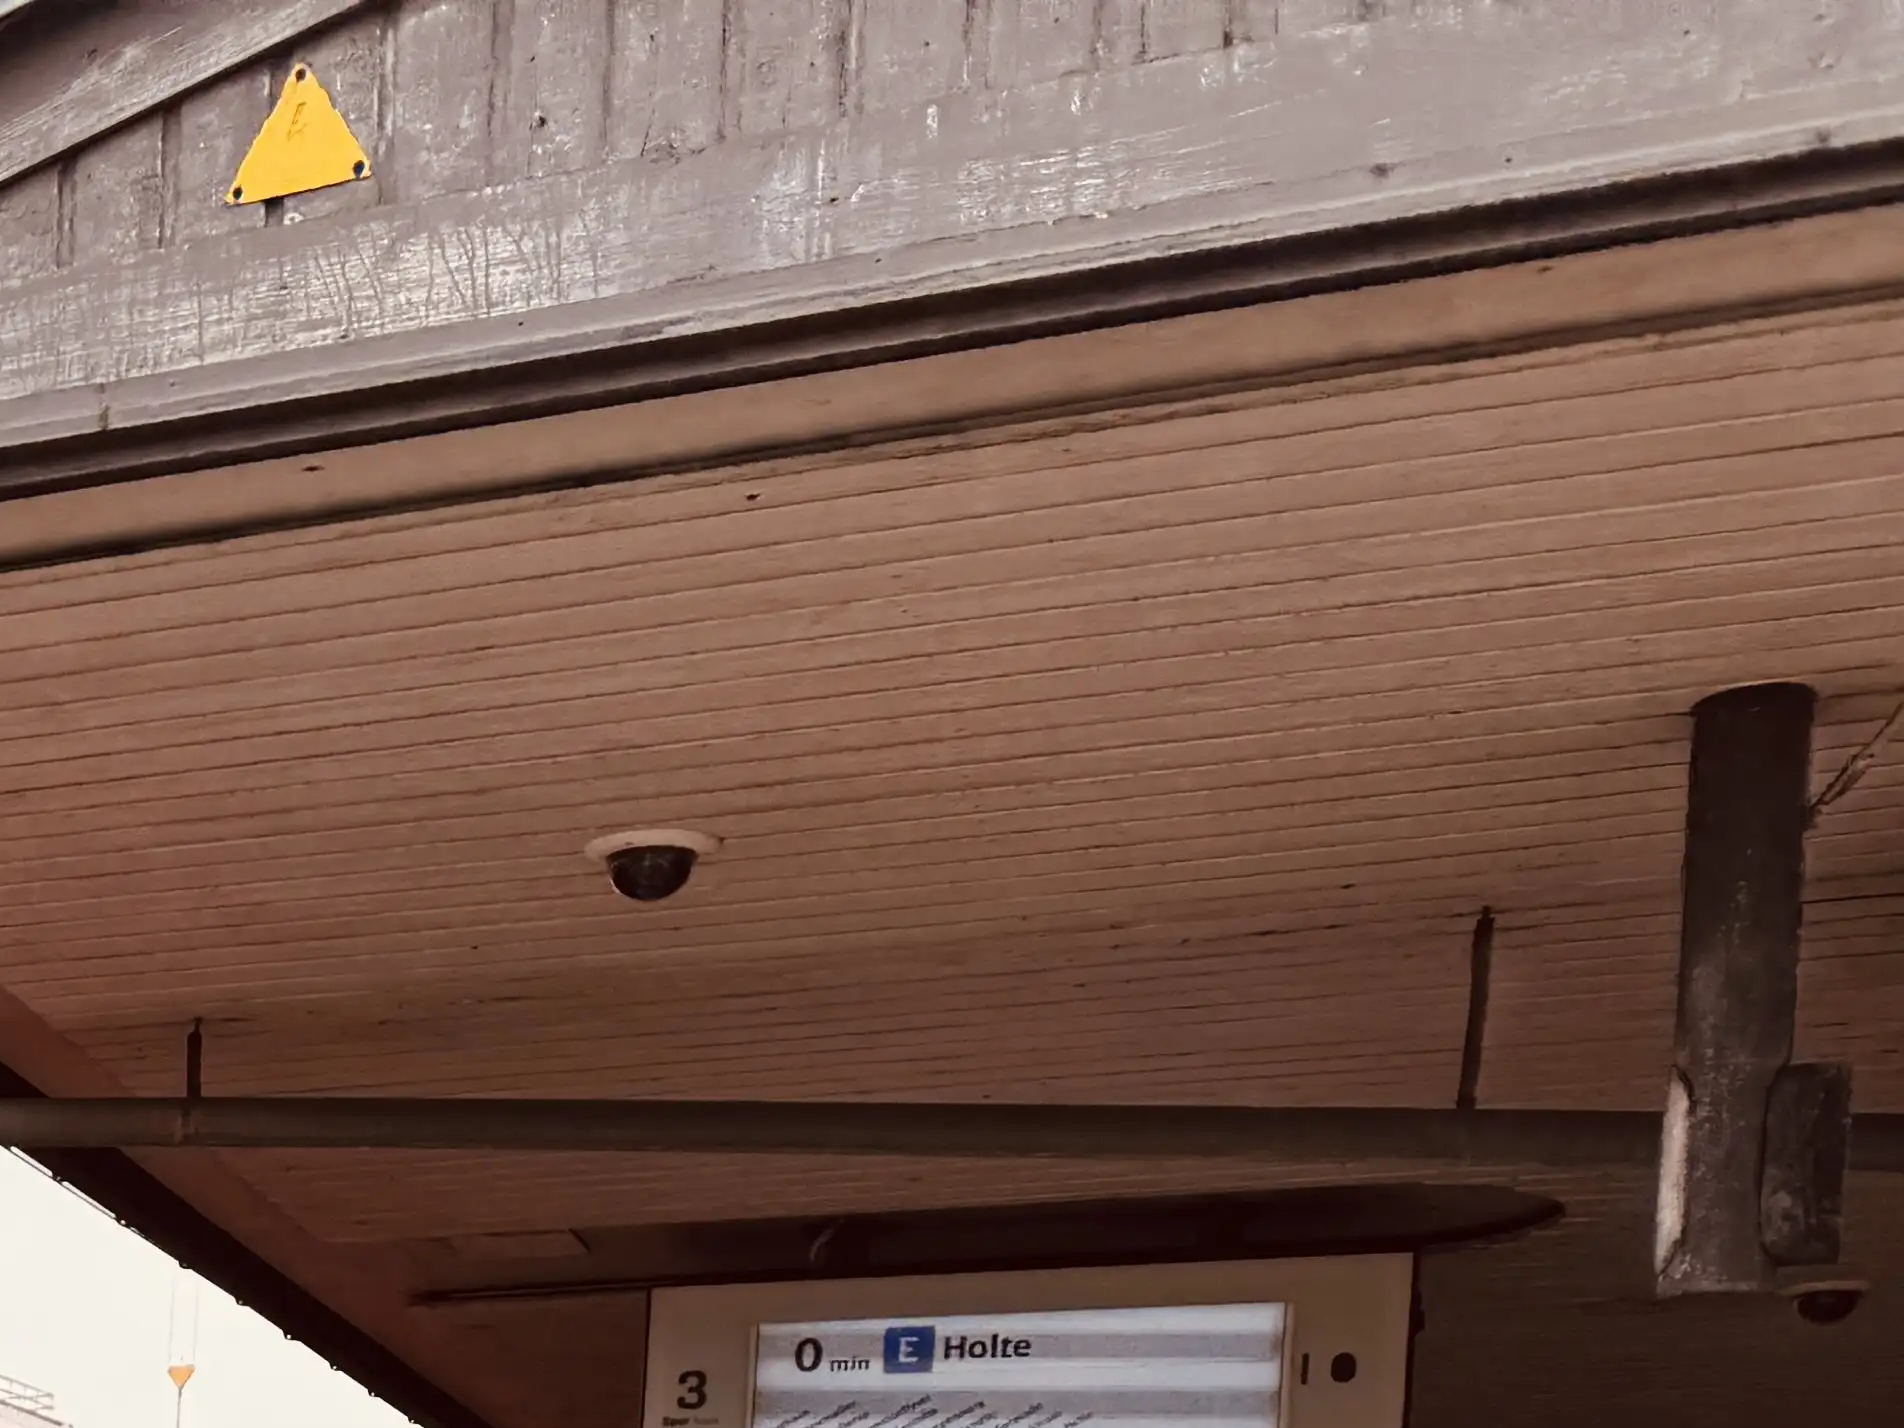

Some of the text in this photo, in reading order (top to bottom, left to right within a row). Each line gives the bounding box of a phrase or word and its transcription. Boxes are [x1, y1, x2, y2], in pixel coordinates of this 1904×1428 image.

[794, 1332, 1033, 1373] 0 min E Holte
[676, 1369, 708, 1410] 3
